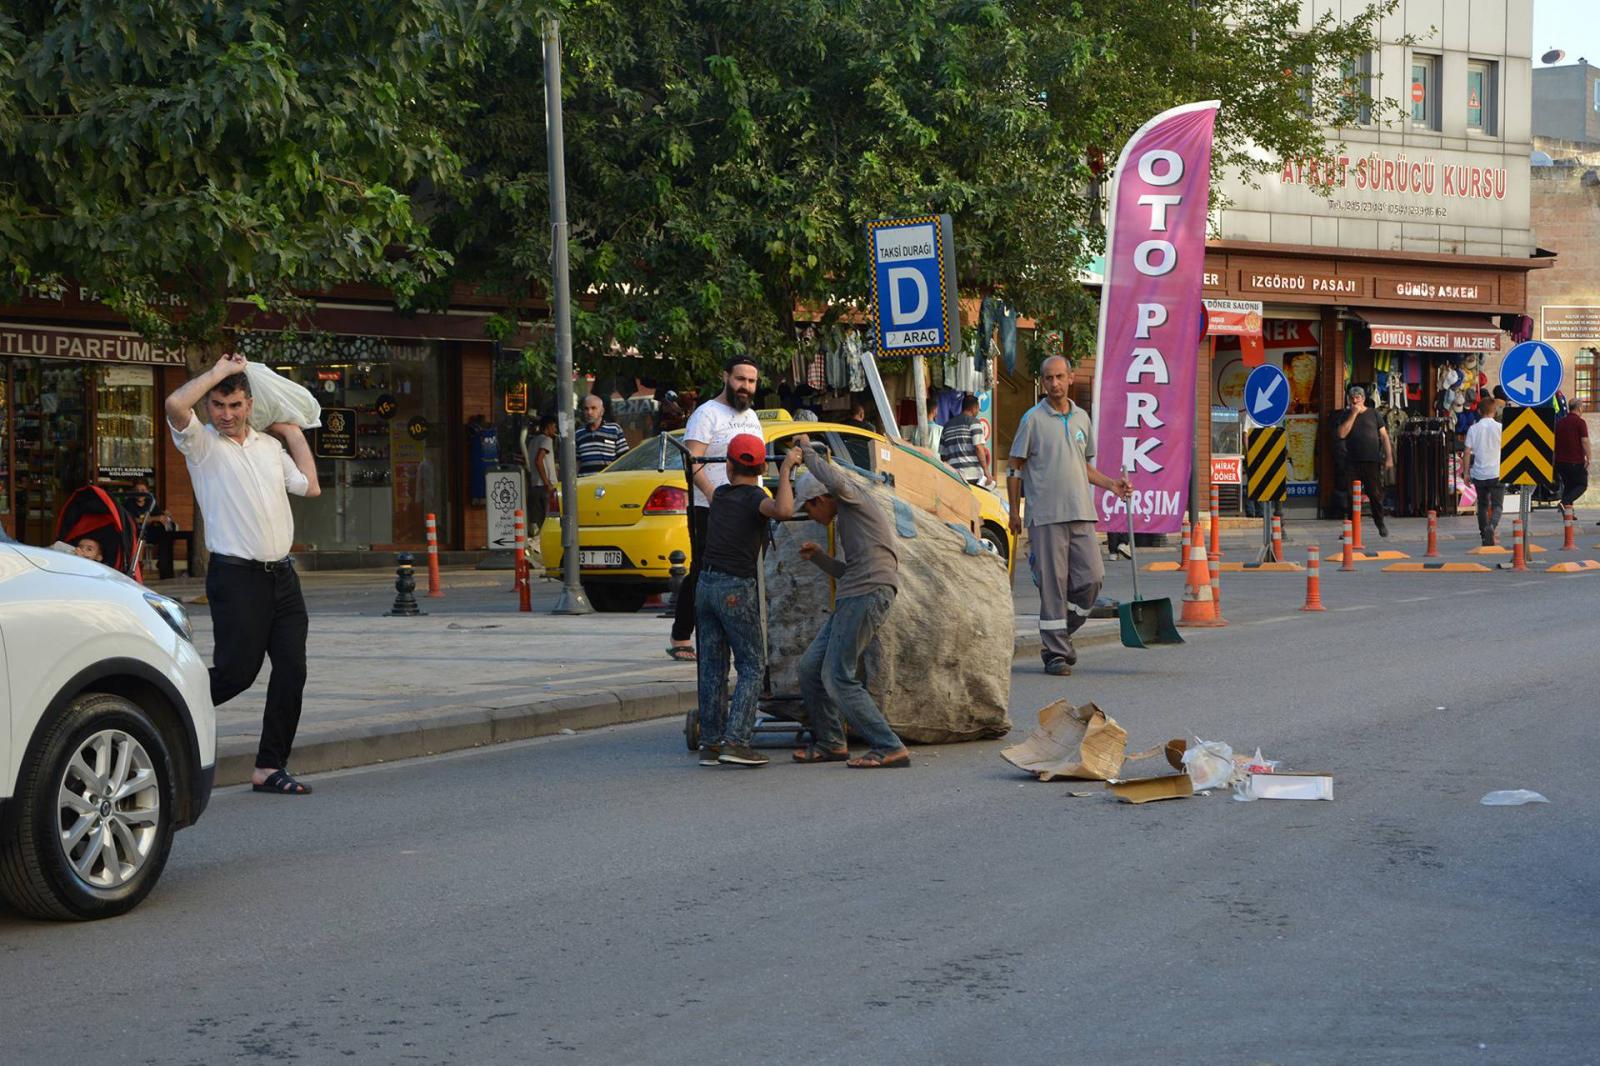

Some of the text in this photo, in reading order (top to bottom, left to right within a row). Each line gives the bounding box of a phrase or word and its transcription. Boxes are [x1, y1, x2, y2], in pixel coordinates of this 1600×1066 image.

[1355, 151, 1436, 195] SÜRÜCÜ
[1442, 163, 1507, 200] KURSU
[879, 243, 932, 259] TAKSİ DURAĞI
[1251, 274, 1356, 293] İZGÖRDÜ PASAJI
[1396, 282, 1479, 299] GÜMÜŞ ASKERİ
[887, 266, 929, 326] D
[1207, 299, 1260, 311] DÖNER SALONU
[903, 330, 937, 345] ARAÇ
[1373, 330, 1496, 349] GÜMÜŞ ASKERİ MALZEME
[1214, 460, 1236, 472] MİRAÇ
[1213, 471, 1237, 481] DÖNER
[1297, 487, 1307, 495] 05
[1308, 486, 1317, 494] 97
[1101, 489, 1181, 523] ÇARŞIM
[590, 551, 595, 564] T
[604, 551, 621, 564] 0176
